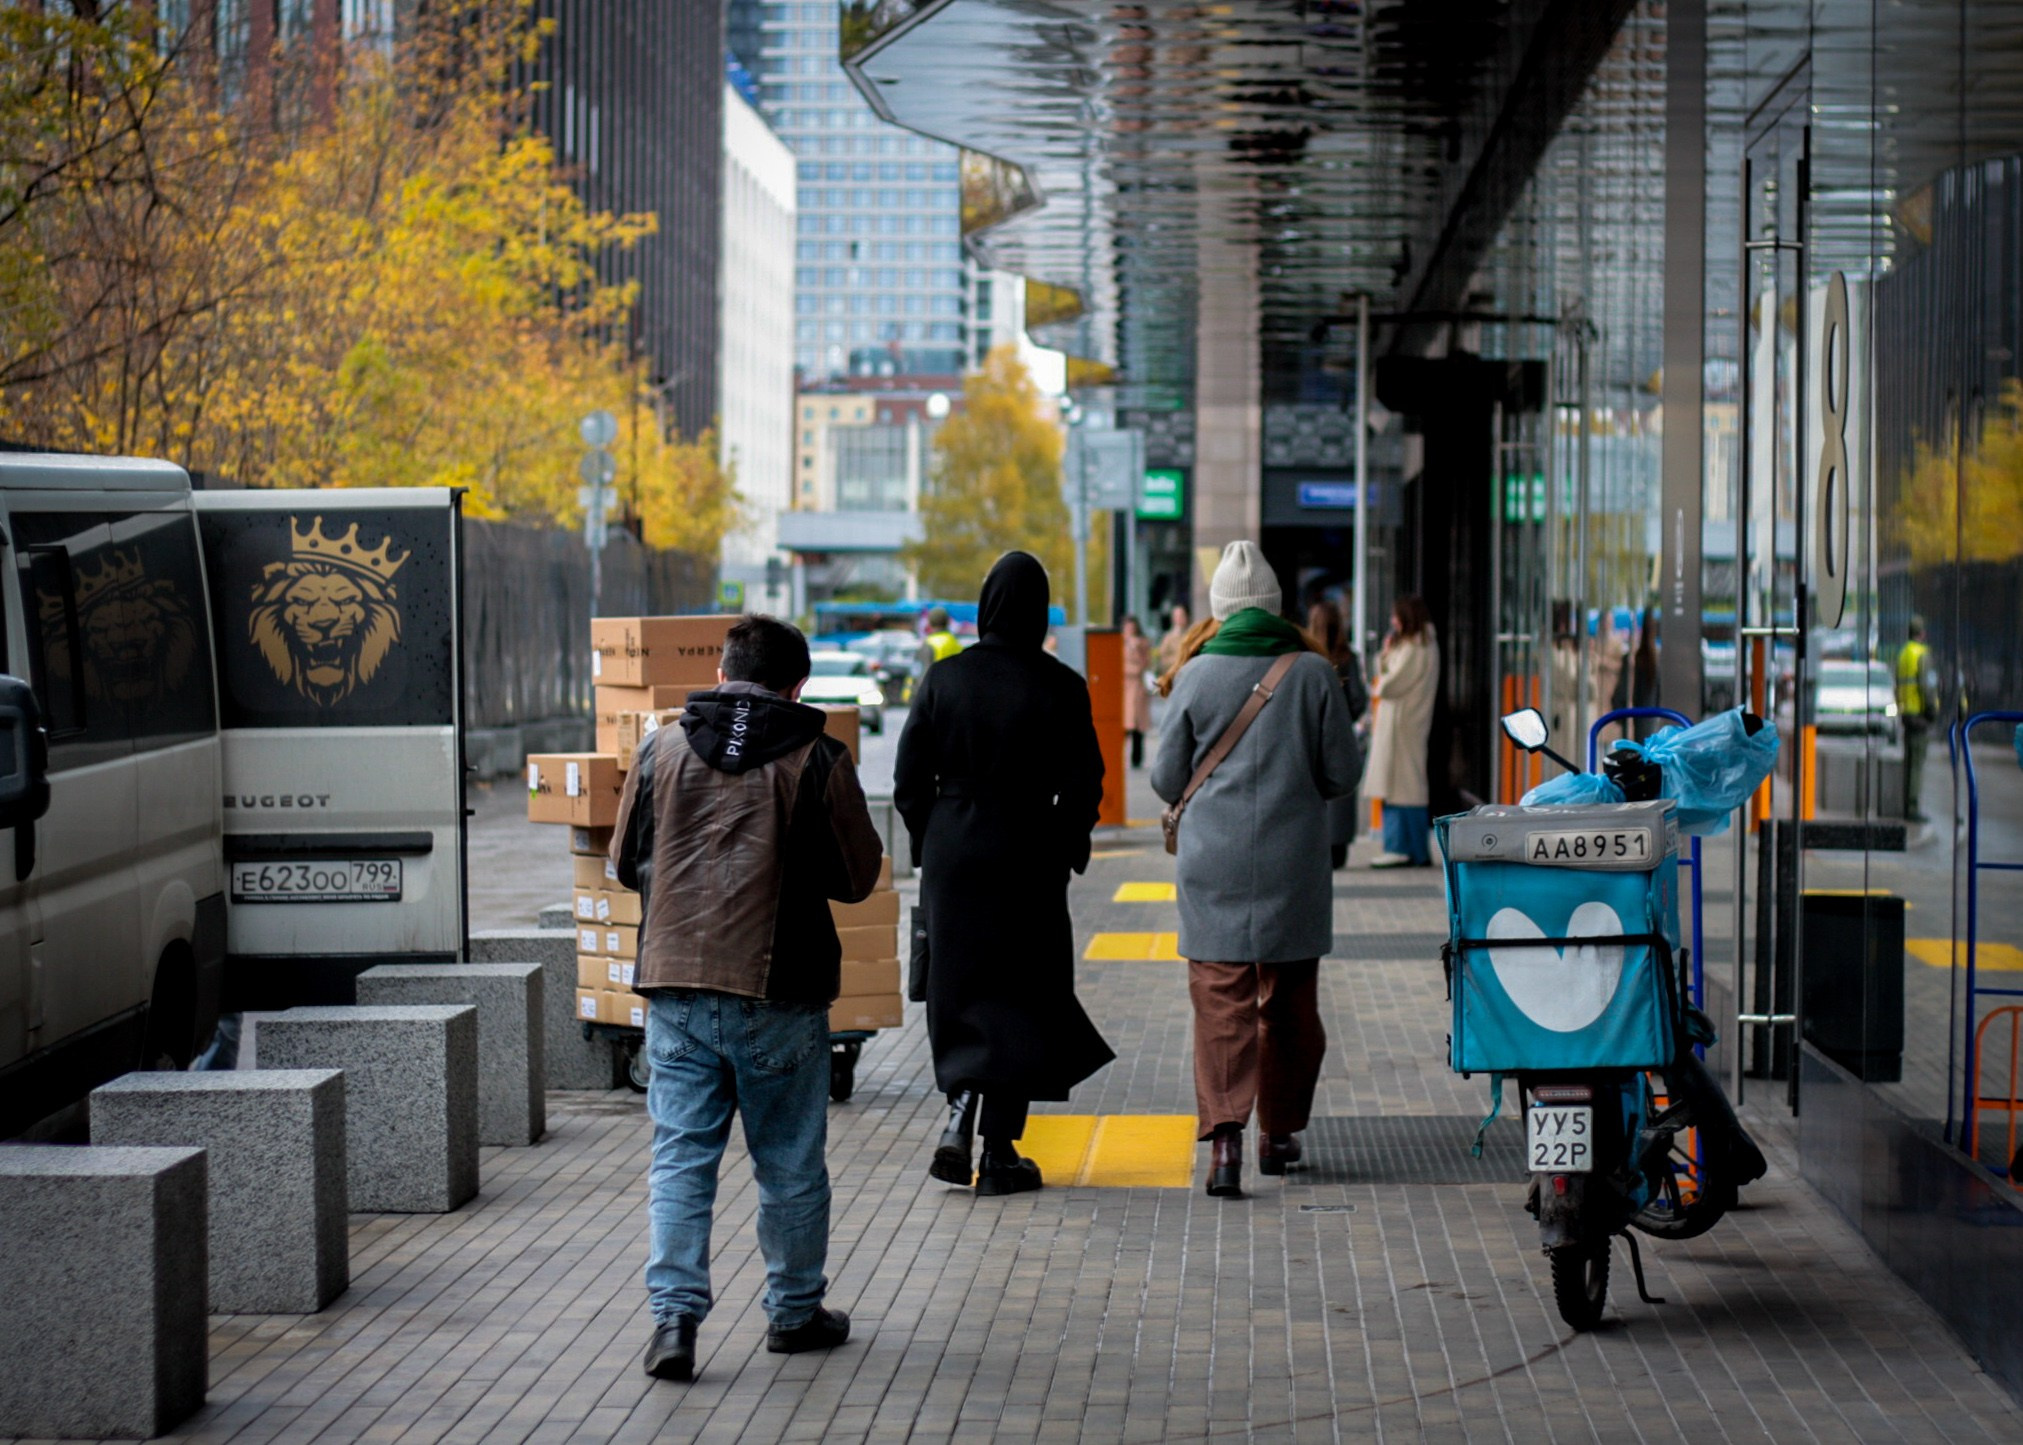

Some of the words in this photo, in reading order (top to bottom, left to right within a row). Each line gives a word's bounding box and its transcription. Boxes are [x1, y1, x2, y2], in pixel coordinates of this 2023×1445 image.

[1817, 270, 1849, 629] 8
[223, 794, 331, 808] EUGEOT
[353, 863, 392, 883] 799
